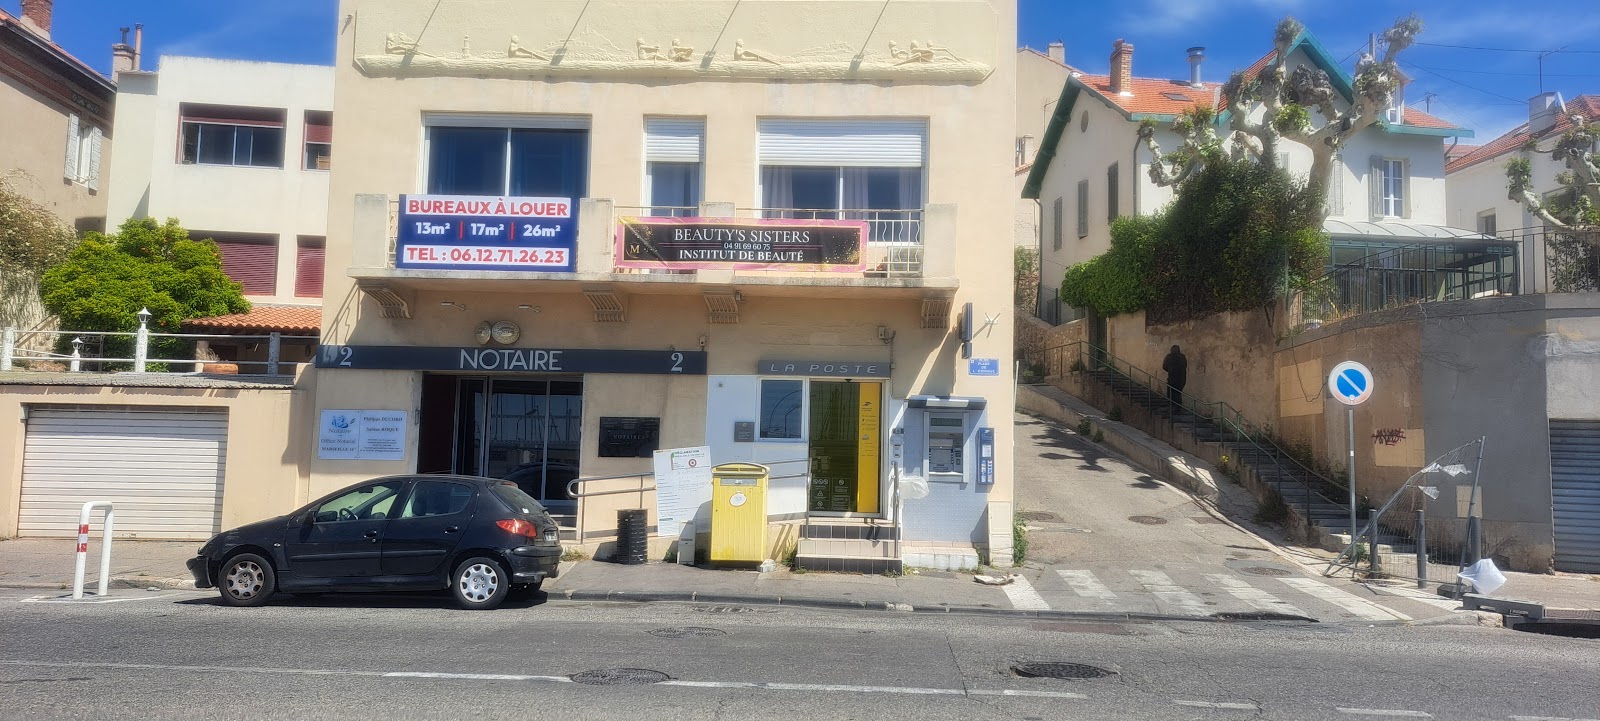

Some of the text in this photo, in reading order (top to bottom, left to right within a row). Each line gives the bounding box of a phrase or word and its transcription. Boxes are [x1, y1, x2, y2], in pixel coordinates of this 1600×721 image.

[409, 198, 567, 215] BUREAUX À LOUER
[415, 222, 561, 237] 13m² 17m² 26m²
[674, 228, 810, 243] BEAUTY'S SISTERS
[630, 244, 640, 254] M
[724, 242, 733, 250] 04
[734, 242, 742, 250] 91
[743, 242, 752, 250] 69
[407, 247, 438, 260] TEL
[450, 249, 564, 263] 06.12.71.26.23
[680, 249, 804, 261] INSTITUT DE BEAUTÉ
[340, 347, 353, 367] 2
[460, 349, 562, 371] NOTAIRE
[671, 352, 684, 373] 2
[770, 364, 878, 374] LA POSTE
